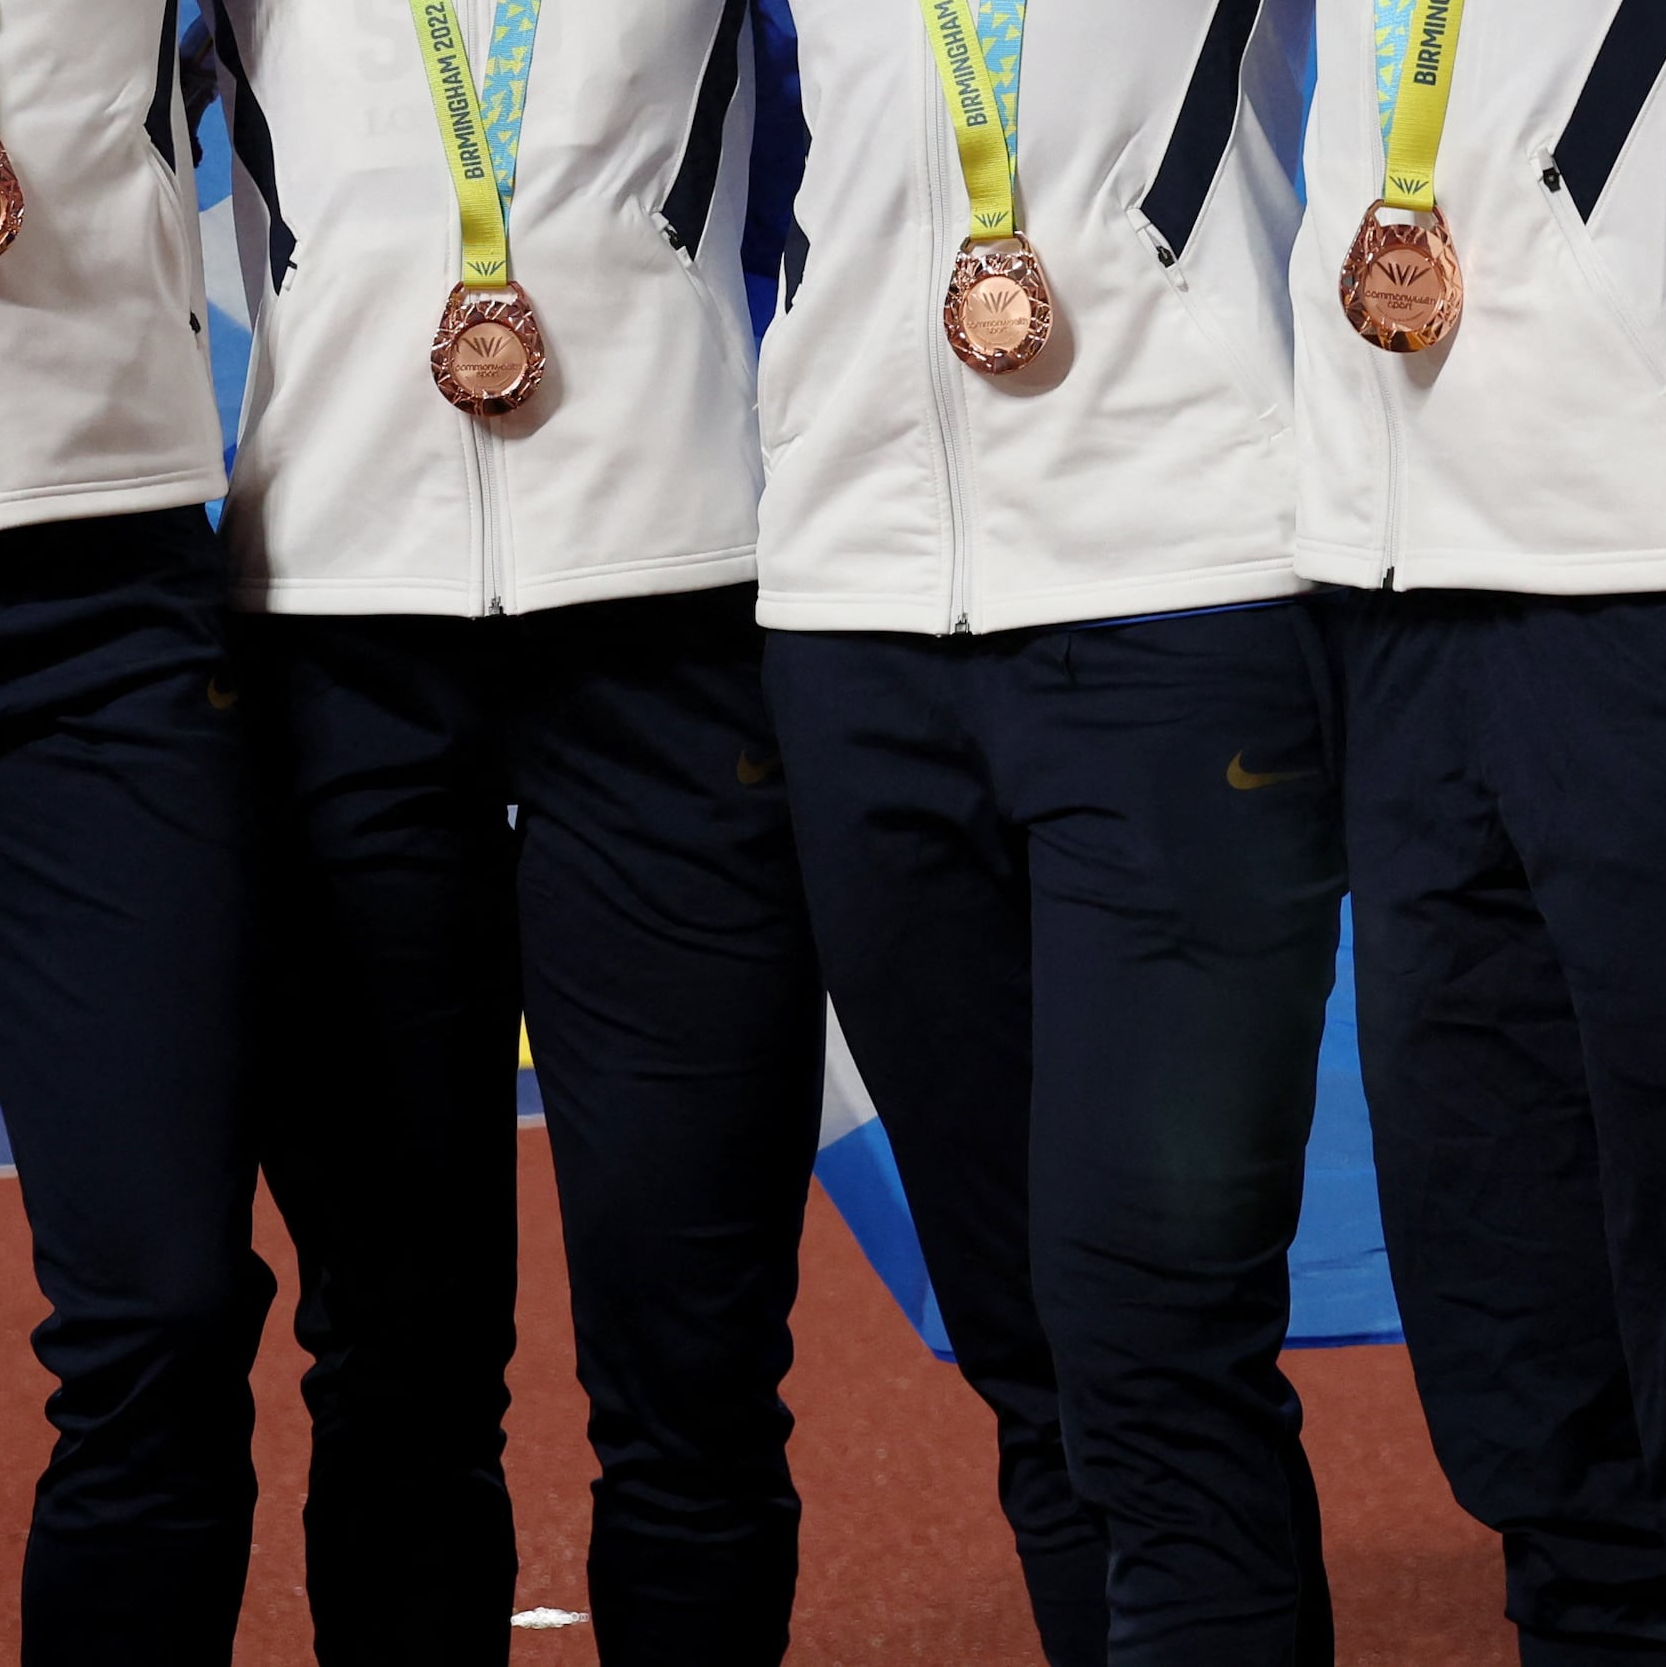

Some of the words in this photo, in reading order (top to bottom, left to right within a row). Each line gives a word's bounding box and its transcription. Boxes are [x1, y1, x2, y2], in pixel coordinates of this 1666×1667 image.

[425, 1, 454, 52] 2022
[934, 0, 988, 127] BIRMINGHAM
[437, 54, 485, 179] BIRMINGHAM
